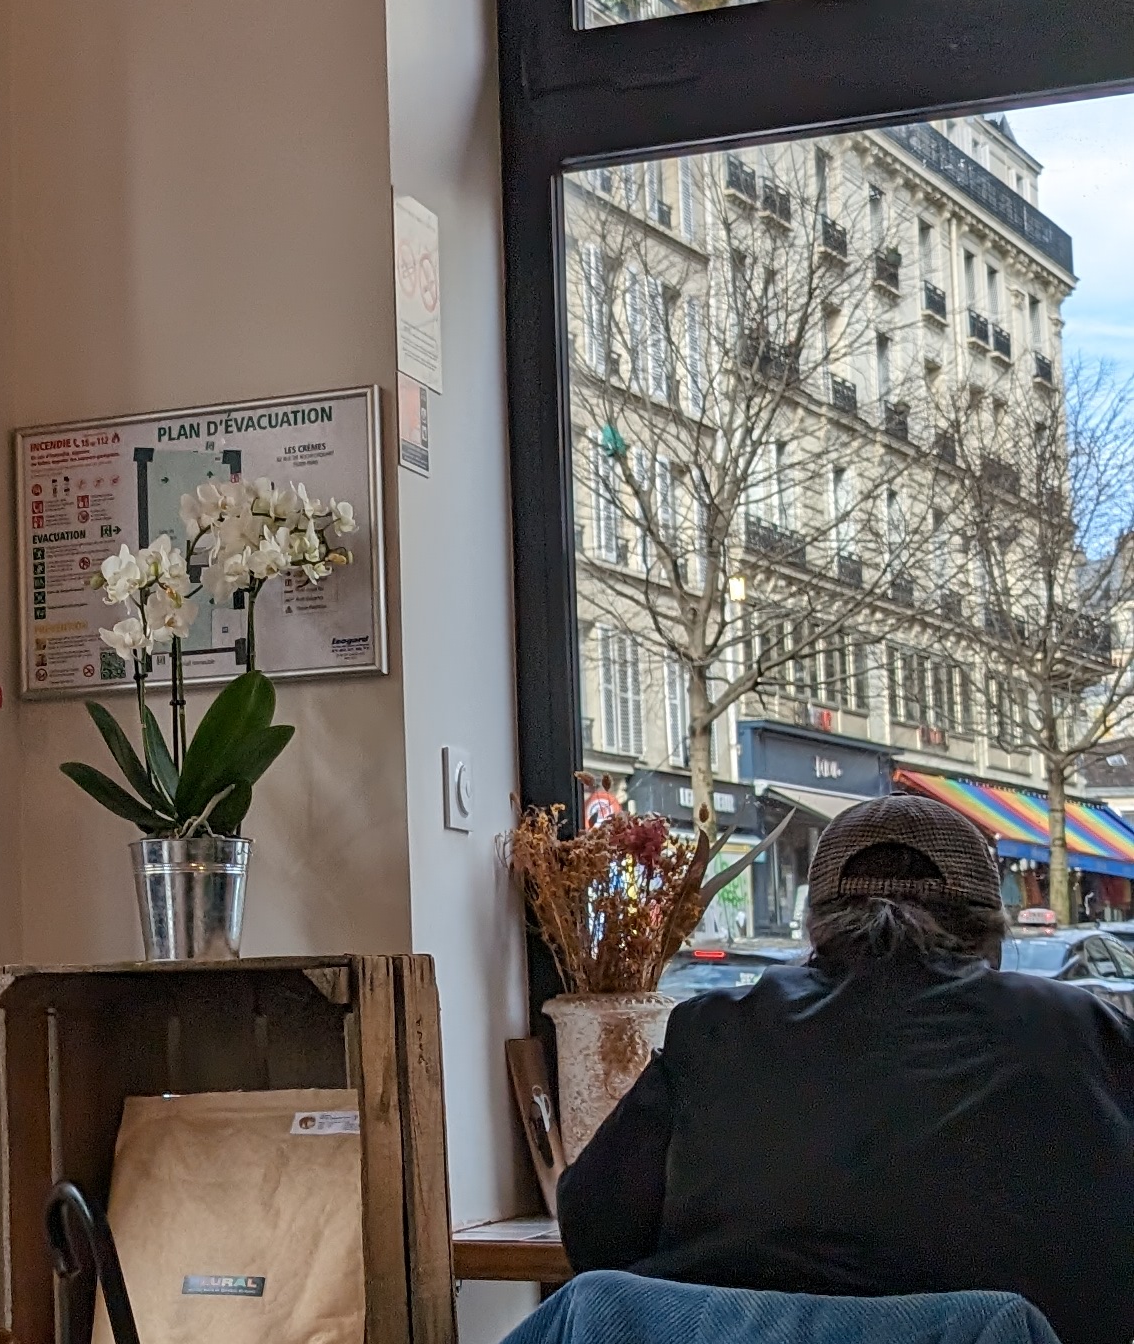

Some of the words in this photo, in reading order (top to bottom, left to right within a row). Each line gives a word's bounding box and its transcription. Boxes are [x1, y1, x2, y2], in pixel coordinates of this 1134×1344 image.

[157, 422, 201, 443] PLAN
[206, 405, 334, 437] D'ÉVACUATION
[30, 438, 71, 452] INCENDIE
